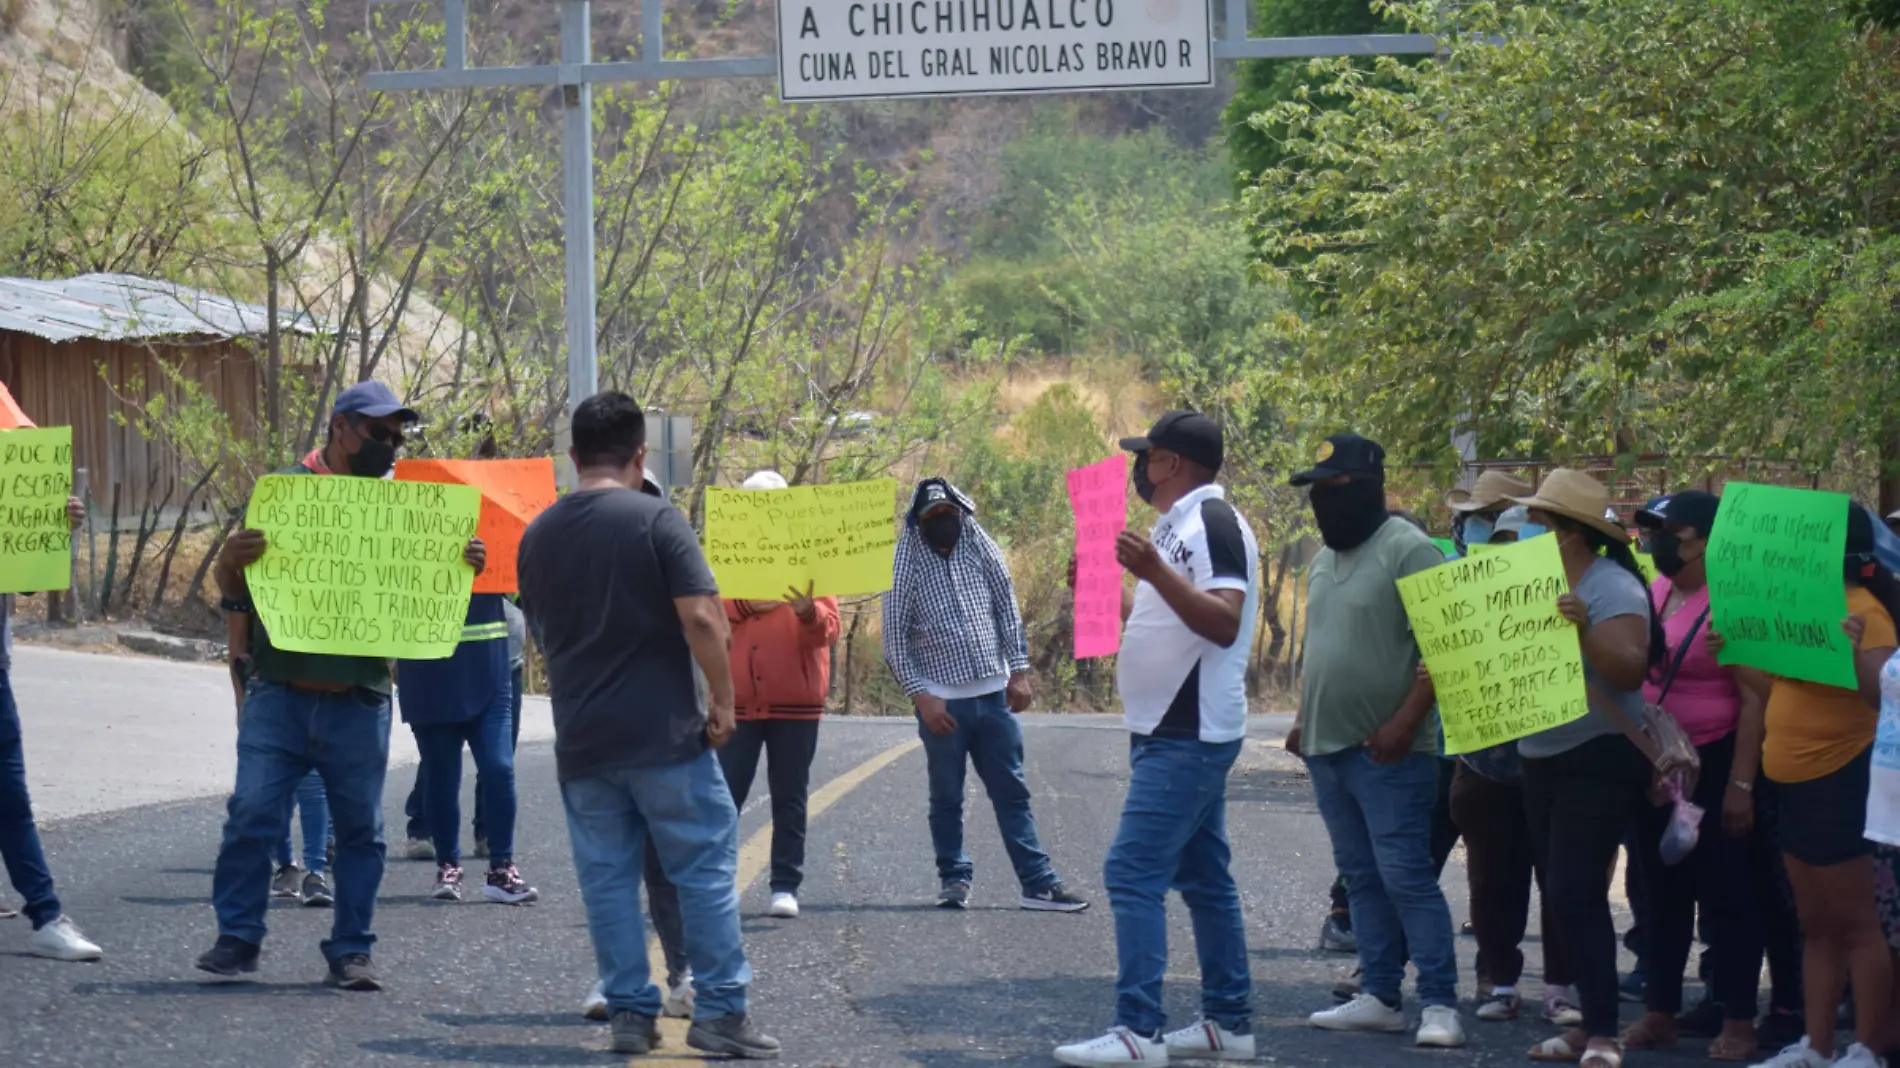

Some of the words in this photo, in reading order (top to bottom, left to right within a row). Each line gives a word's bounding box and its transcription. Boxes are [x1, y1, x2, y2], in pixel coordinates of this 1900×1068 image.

[800, 6, 820, 39] A
[848, 0, 1115, 37] CHICHIHUALCO
[800, 52, 857, 81] CUNA
[869, 49, 910, 79] DEL
[921, 47, 978, 77] GRAL
[990, 43, 1084, 75] NICOLAS
[1097, 39, 1167, 71] BRAVO
[1179, 39, 1192, 68] R
[260, 477, 296, 504] SOY
[416, 484, 447, 509] POR
[257, 504, 291, 526] LAS
[297, 503, 353, 528] BALAS
[359, 508, 369, 527] Y
[375, 507, 394, 532] LA
[359, 535, 382, 560] MI
[392, 537, 460, 563] PUEBLO
[788, 551, 809, 566] de
[376, 564, 422, 592] VIVIR
[291, 588, 302, 610] Y
[310, 588, 364, 615] VIVIR
[1441, 601, 1477, 625] NOS
[1475, 659, 1494, 680] DE
[1479, 682, 1506, 702] POR
[1509, 666, 1560, 695] PARTE
[1565, 661, 1582, 684] DE
[1466, 695, 1543, 724] FEDERAL
